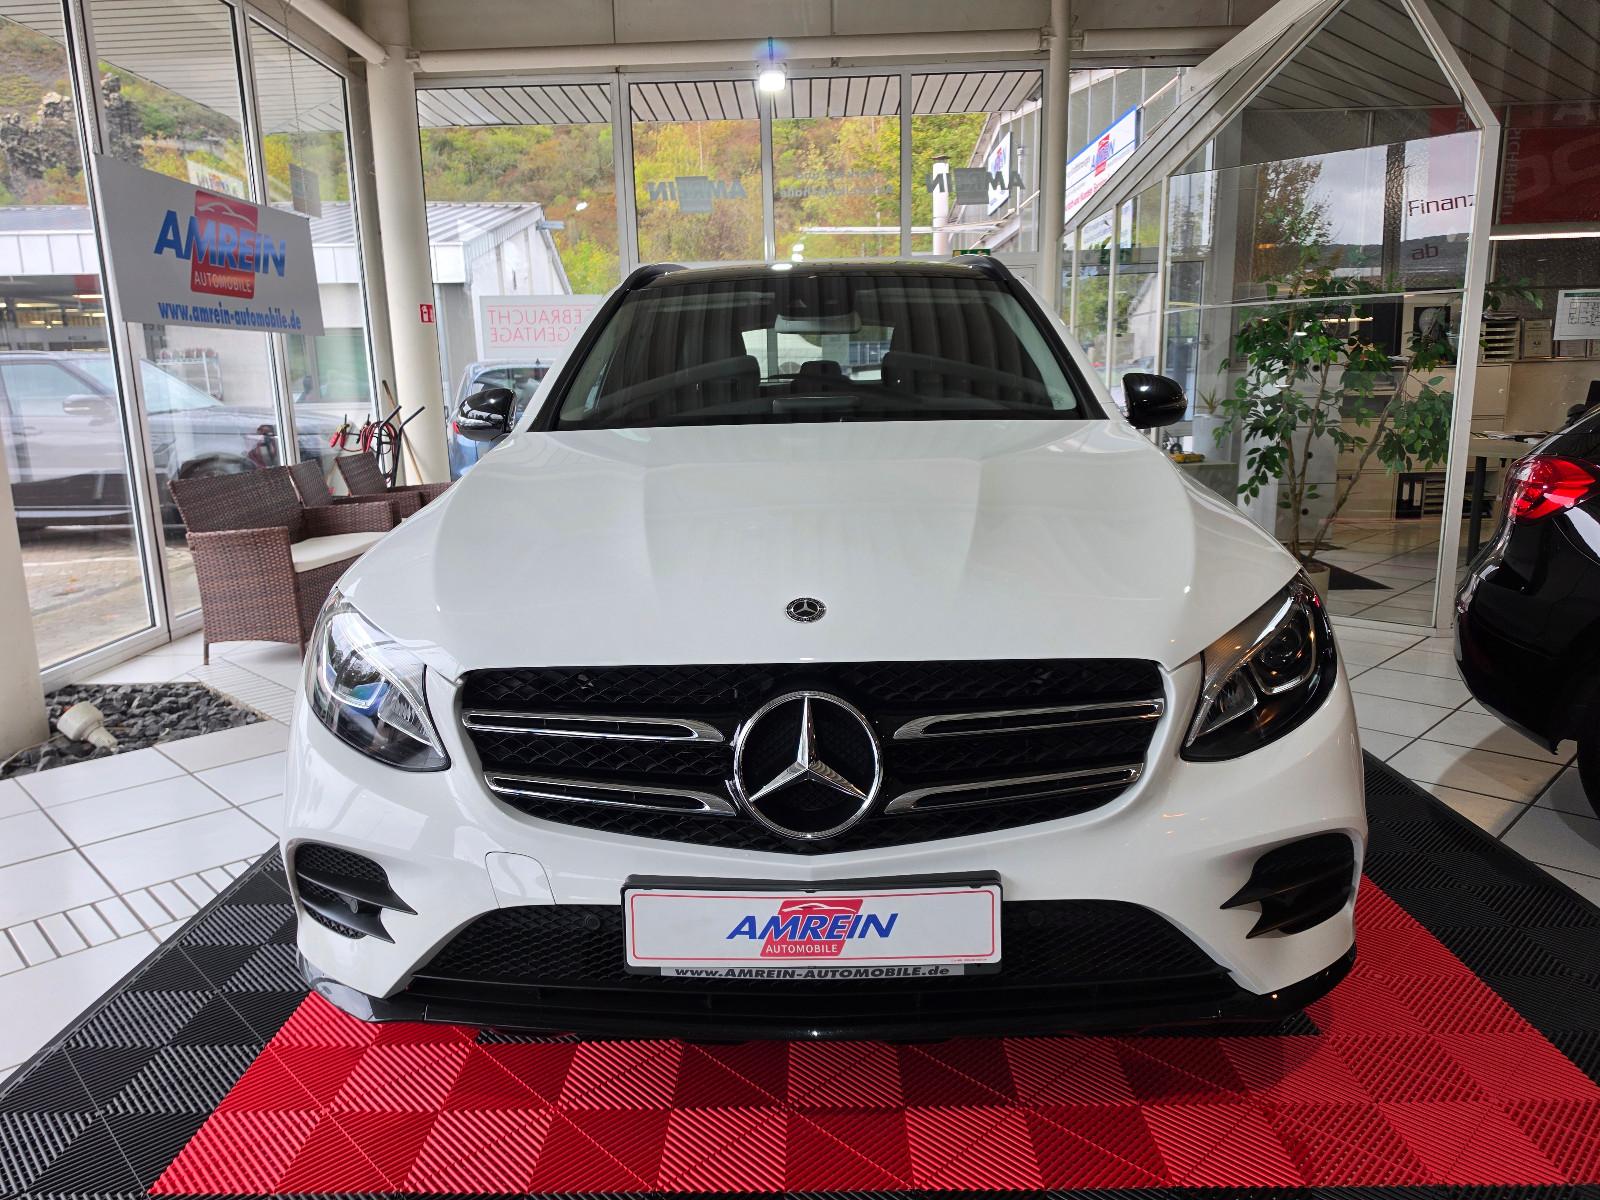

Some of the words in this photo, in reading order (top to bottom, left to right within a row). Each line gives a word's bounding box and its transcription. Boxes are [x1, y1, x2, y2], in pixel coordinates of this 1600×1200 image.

[154, 210, 287, 277] AMREIN
[1411, 243, 1439, 260] ab
[194, 270, 252, 293] AUTOMOBILE
[157, 301, 302, 330] www.amrein-automobile.de
[726, 913, 899, 941] AMREIN
[765, 944, 838, 954] AUTOMOBILE
[674, 965, 950, 979] www.AMREIN-AUTOMOBILE.de
